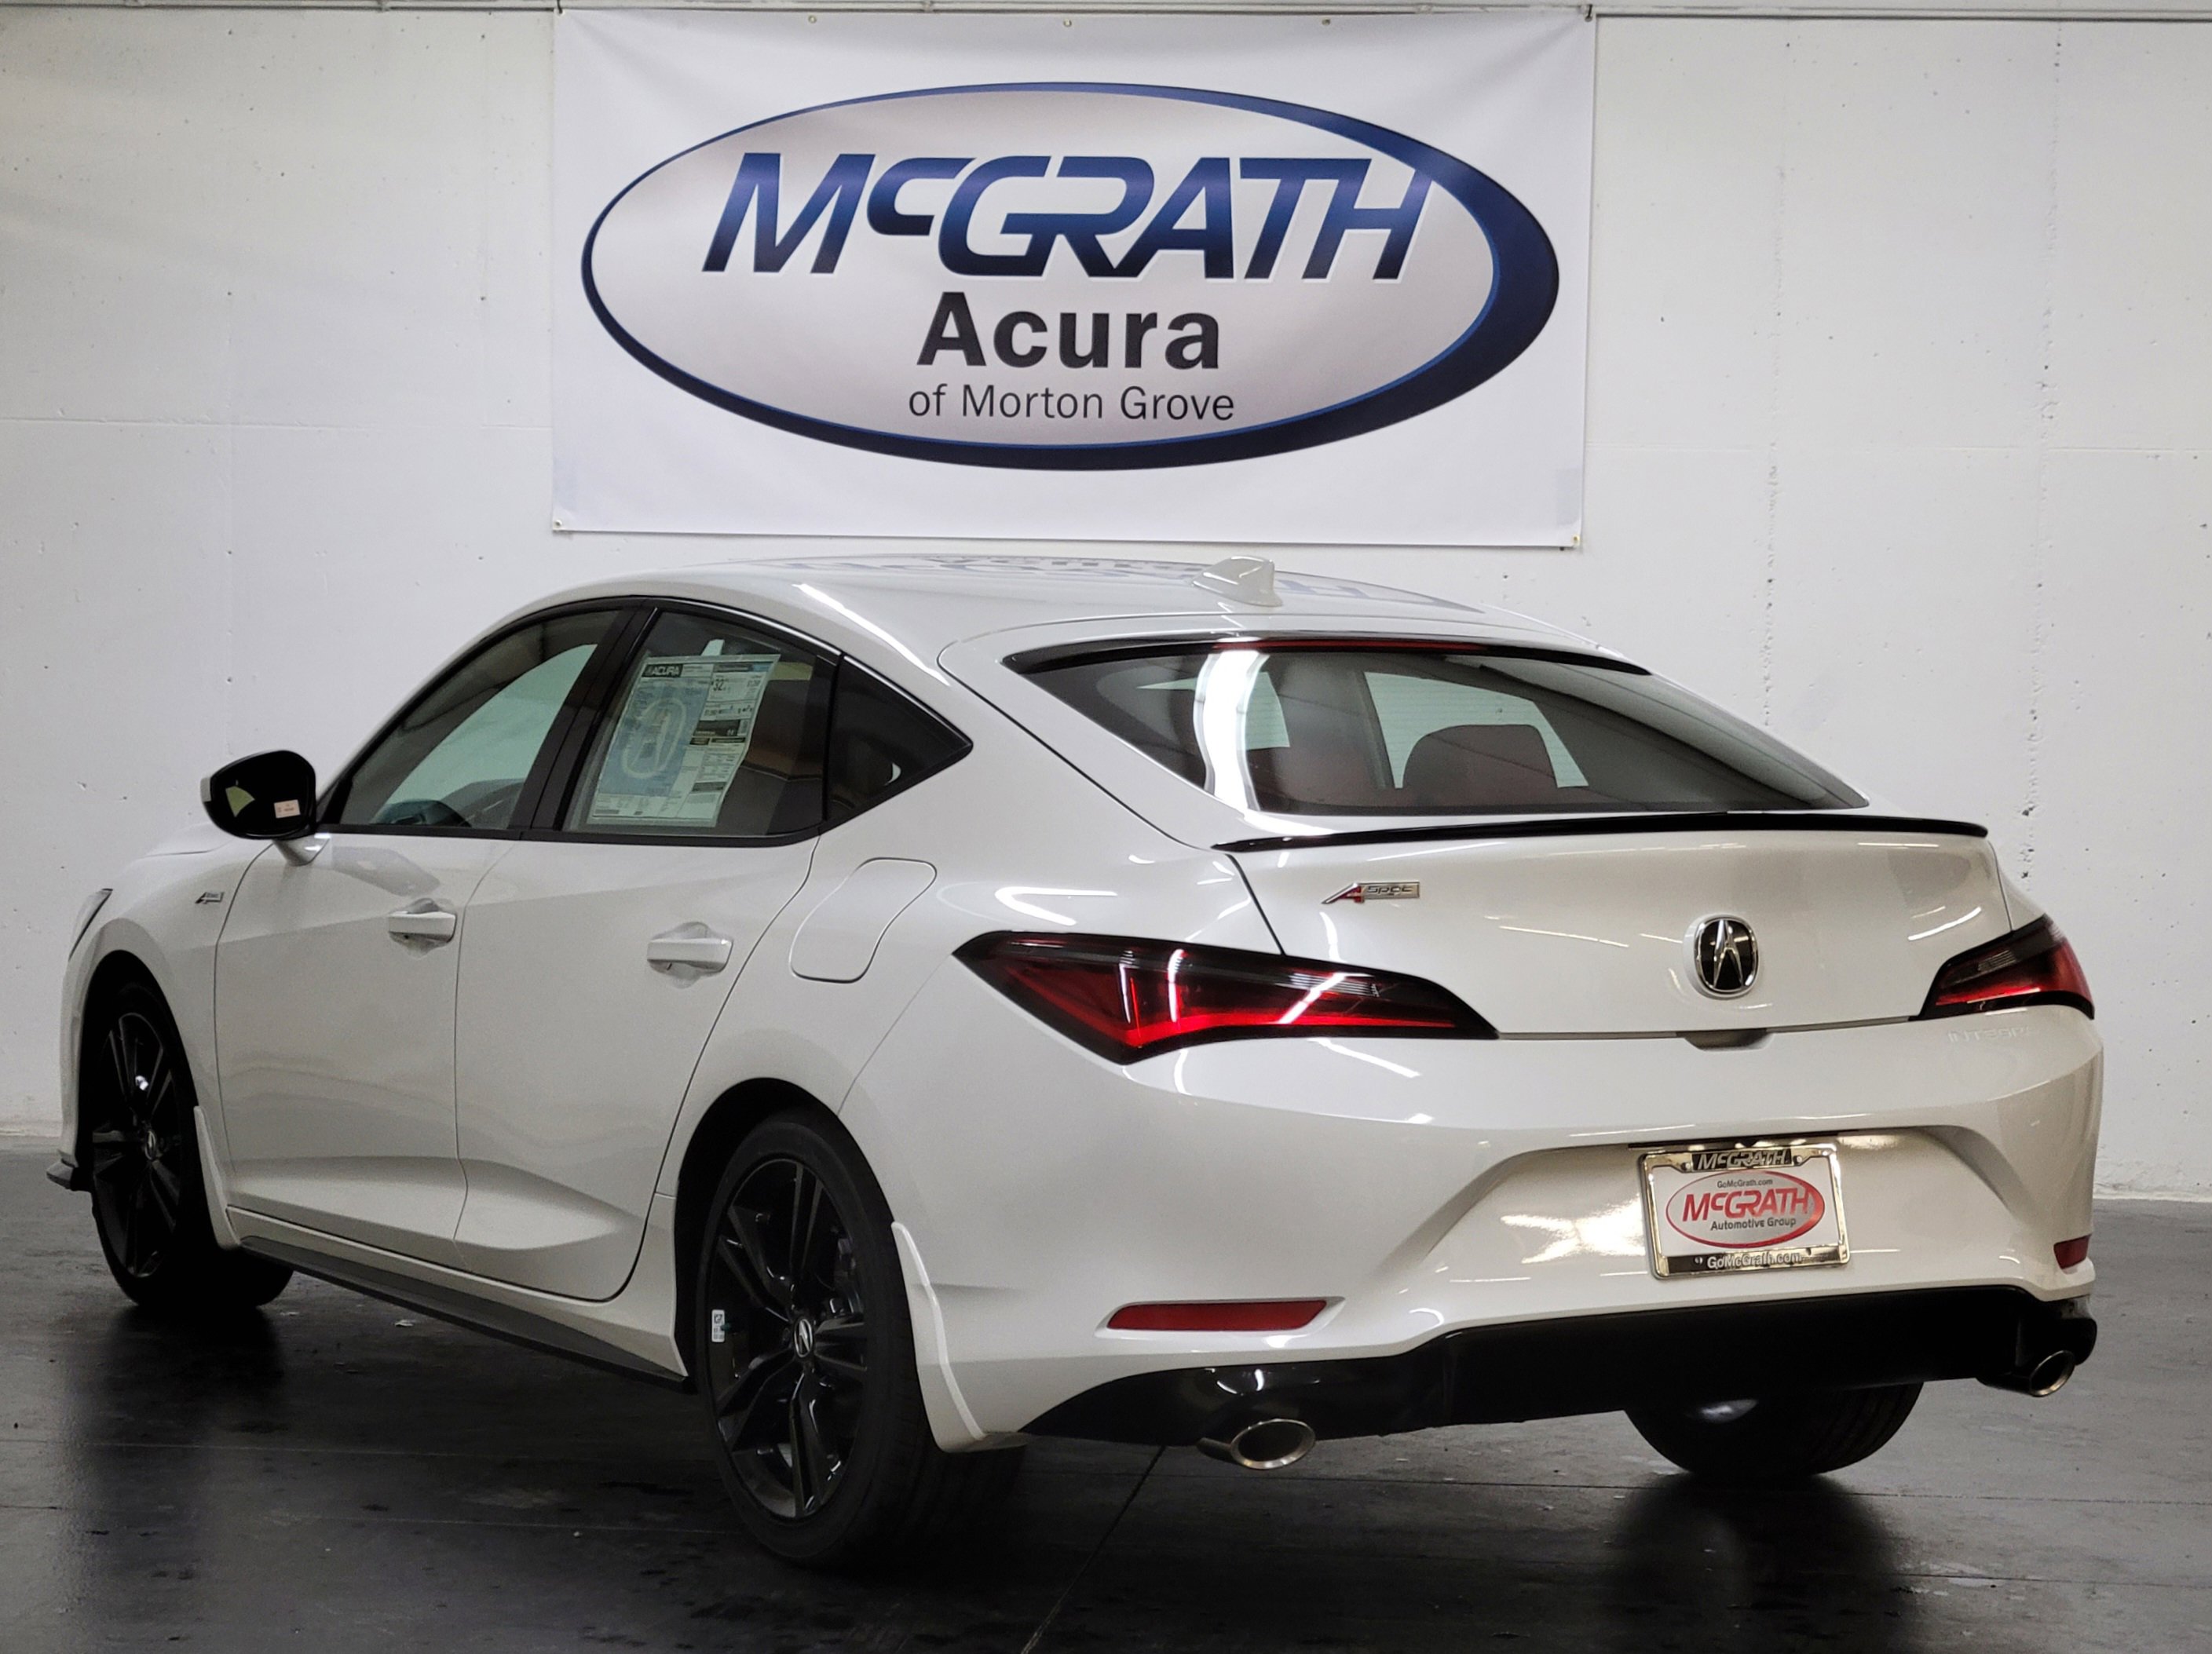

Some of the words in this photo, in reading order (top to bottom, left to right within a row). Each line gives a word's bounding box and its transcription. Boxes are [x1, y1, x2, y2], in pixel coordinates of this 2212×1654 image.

[701, 152, 1432, 281] McGRATH
[917, 291, 1220, 370] Acura
[909, 383, 949, 418] of
[962, 385, 1102, 420] Morton
[1121, 387, 1235, 422] Grove
[1717, 1178, 1773, 1188] GoMcGrath.com
[1682, 1188, 1811, 1221] McGRATH
[1710, 1218, 1764, 1231] Automotive
[1767, 1217, 1797, 1229] Group
